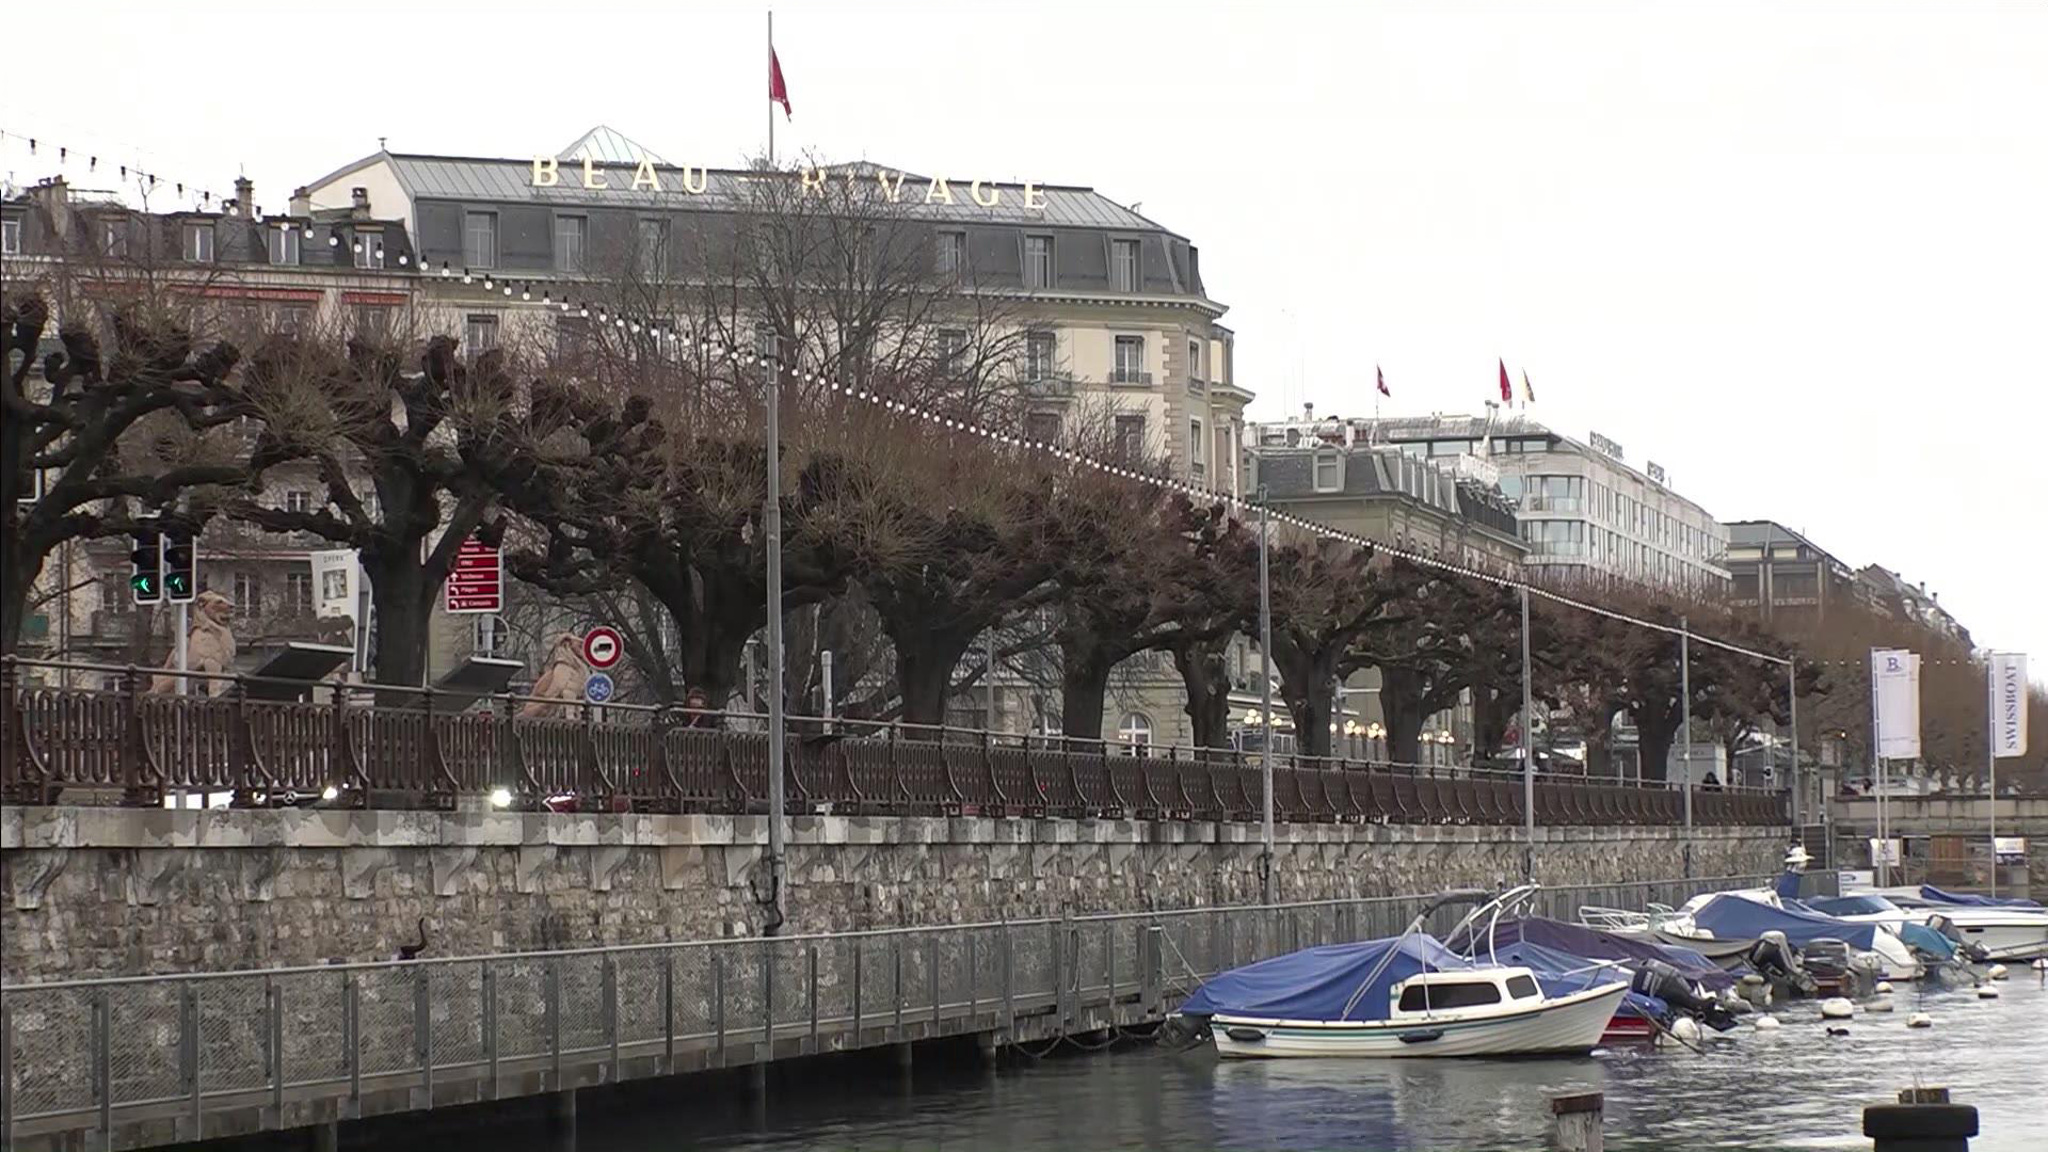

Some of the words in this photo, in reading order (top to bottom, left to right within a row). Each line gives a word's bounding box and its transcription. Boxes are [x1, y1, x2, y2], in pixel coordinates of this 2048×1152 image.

[532, 155, 708, 194] BEAU
[801, 167, 1048, 208] RIVAGE
[2005, 664, 2019, 750] SWISSBOAT
